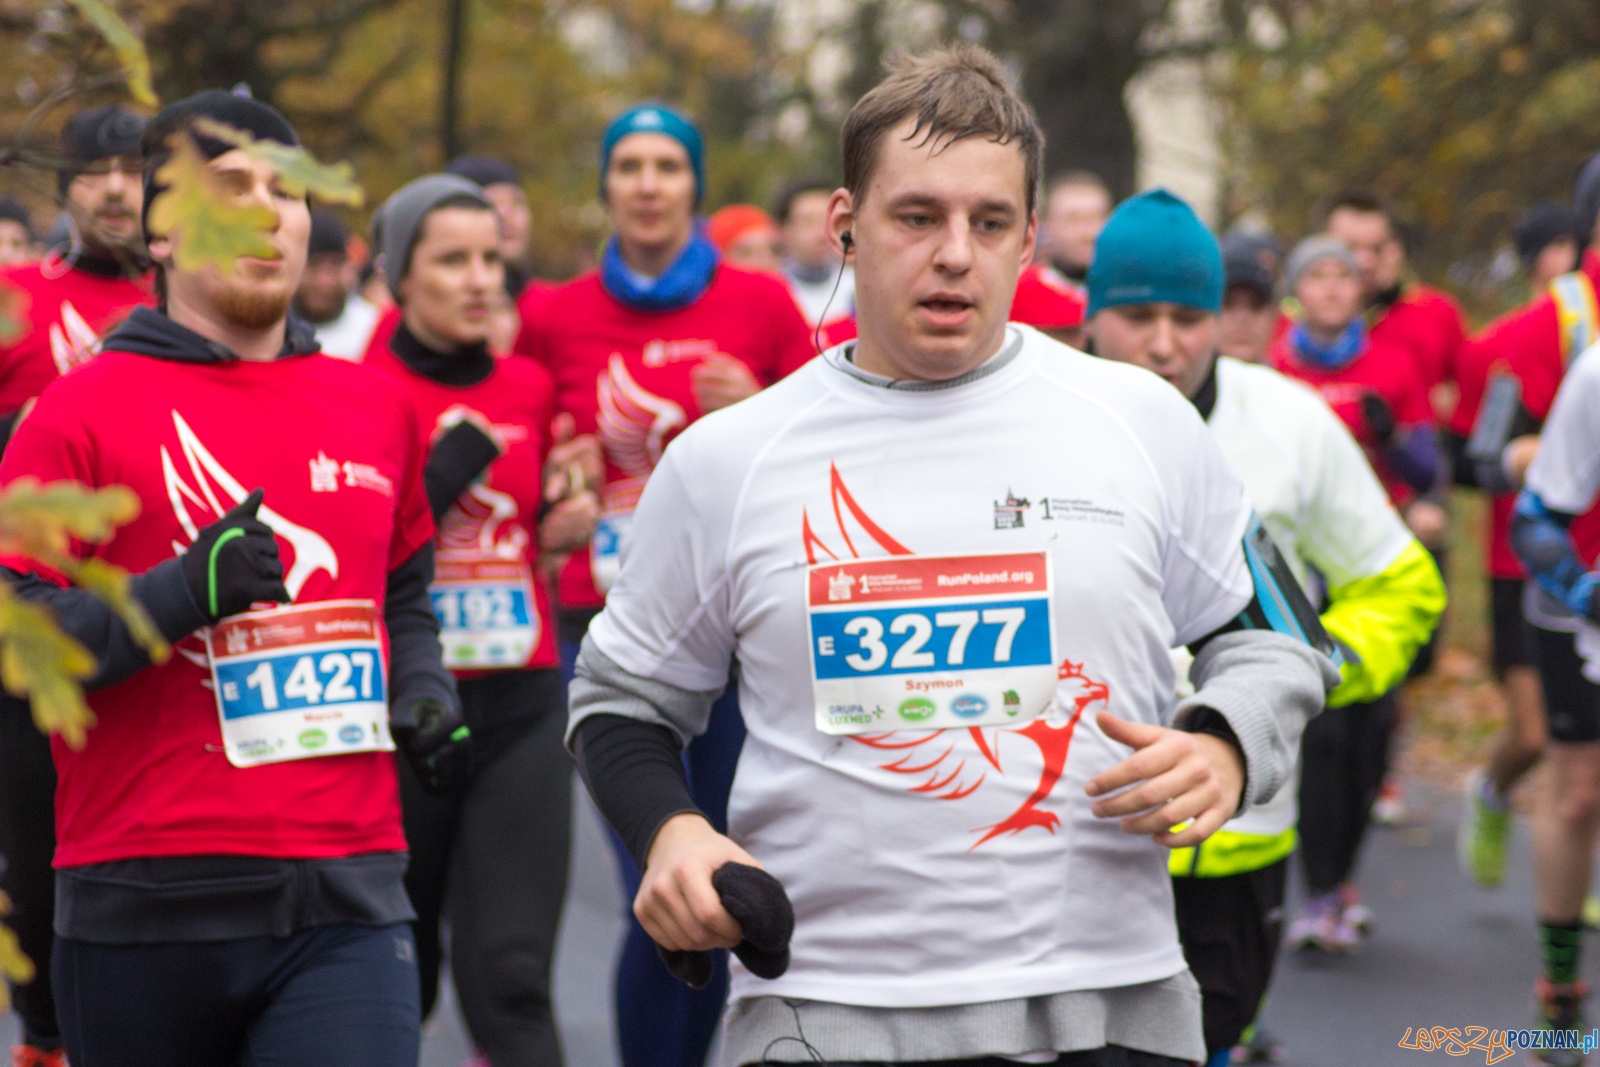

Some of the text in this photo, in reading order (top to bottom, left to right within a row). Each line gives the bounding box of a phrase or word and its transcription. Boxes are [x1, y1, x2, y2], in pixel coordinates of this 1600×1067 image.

[1039, 497, 1054, 520] 1
[858, 574, 871, 594] 1
[937, 570, 1034, 587] RunPoland.org
[818, 606, 1026, 672] E 3277
[222, 651, 375, 711] E 1427
[905, 678, 964, 692] Szymon
[828, 714, 873, 726] LUXMED
